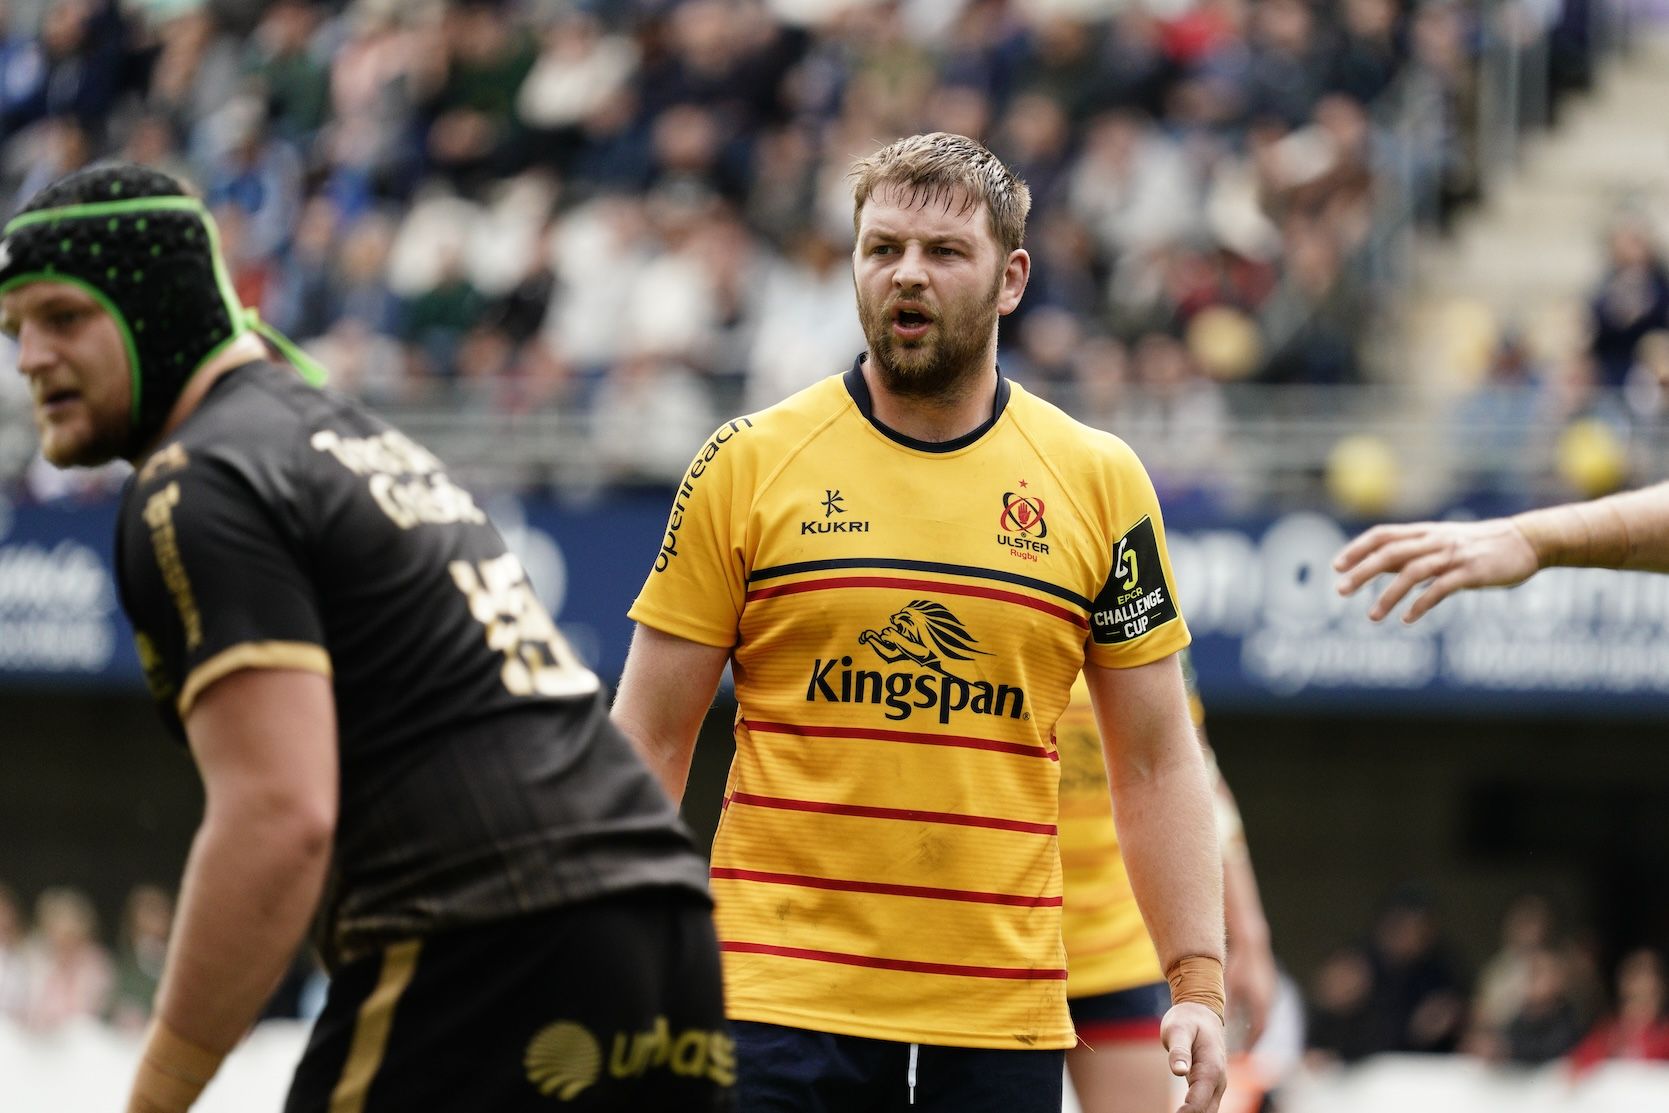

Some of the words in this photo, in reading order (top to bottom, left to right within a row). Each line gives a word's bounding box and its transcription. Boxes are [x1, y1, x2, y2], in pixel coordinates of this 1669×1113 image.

[654, 416, 754, 573] openreach
[801, 520, 870, 535] KUKRI
[997, 534, 1050, 555] ULSTER
[1010, 548, 1038, 562] Rugby
[1094, 587, 1165, 626] CHALLENGE
[1117, 586, 1143, 605] EPCR
[1124, 615, 1149, 638] CUP
[806, 655, 1025, 725] Kingspan
